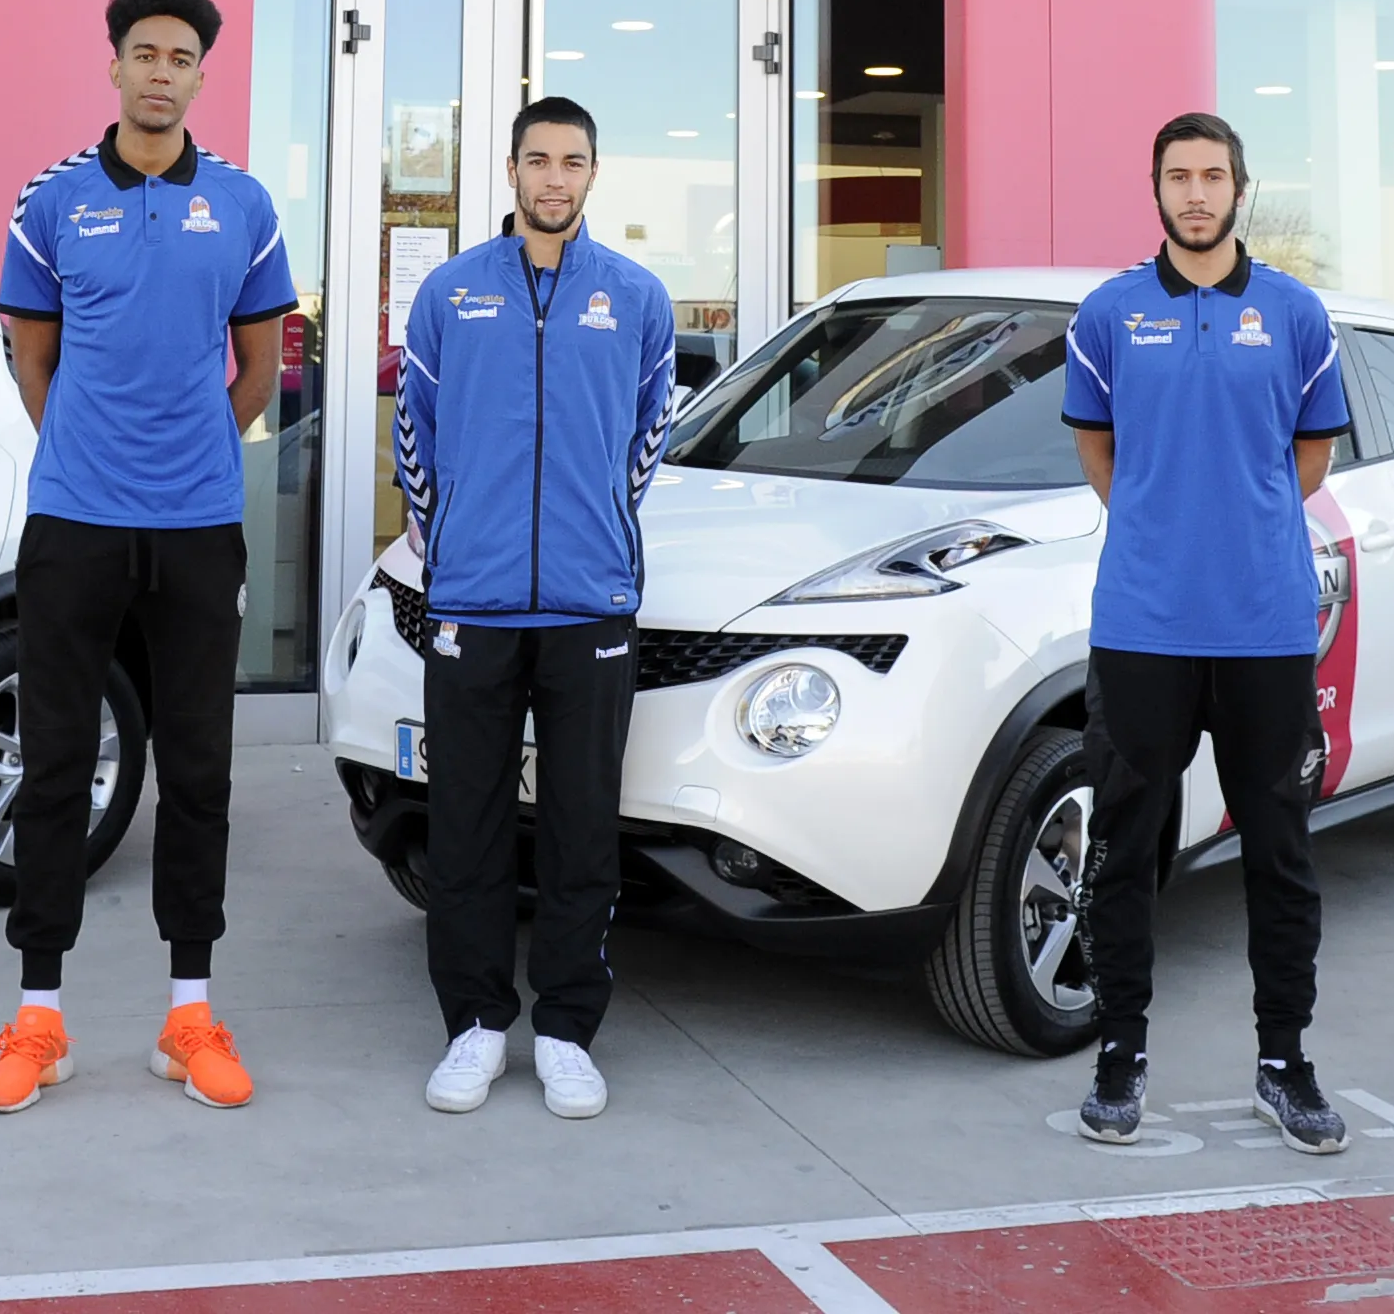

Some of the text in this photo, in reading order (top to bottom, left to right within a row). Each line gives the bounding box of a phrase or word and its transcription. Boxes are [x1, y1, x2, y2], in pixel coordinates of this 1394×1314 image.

[78, 221, 120, 238] hummel
[457, 306, 498, 321] hummel
[1131, 331, 1173, 346] hummel
[595, 642, 629, 660] hummel
